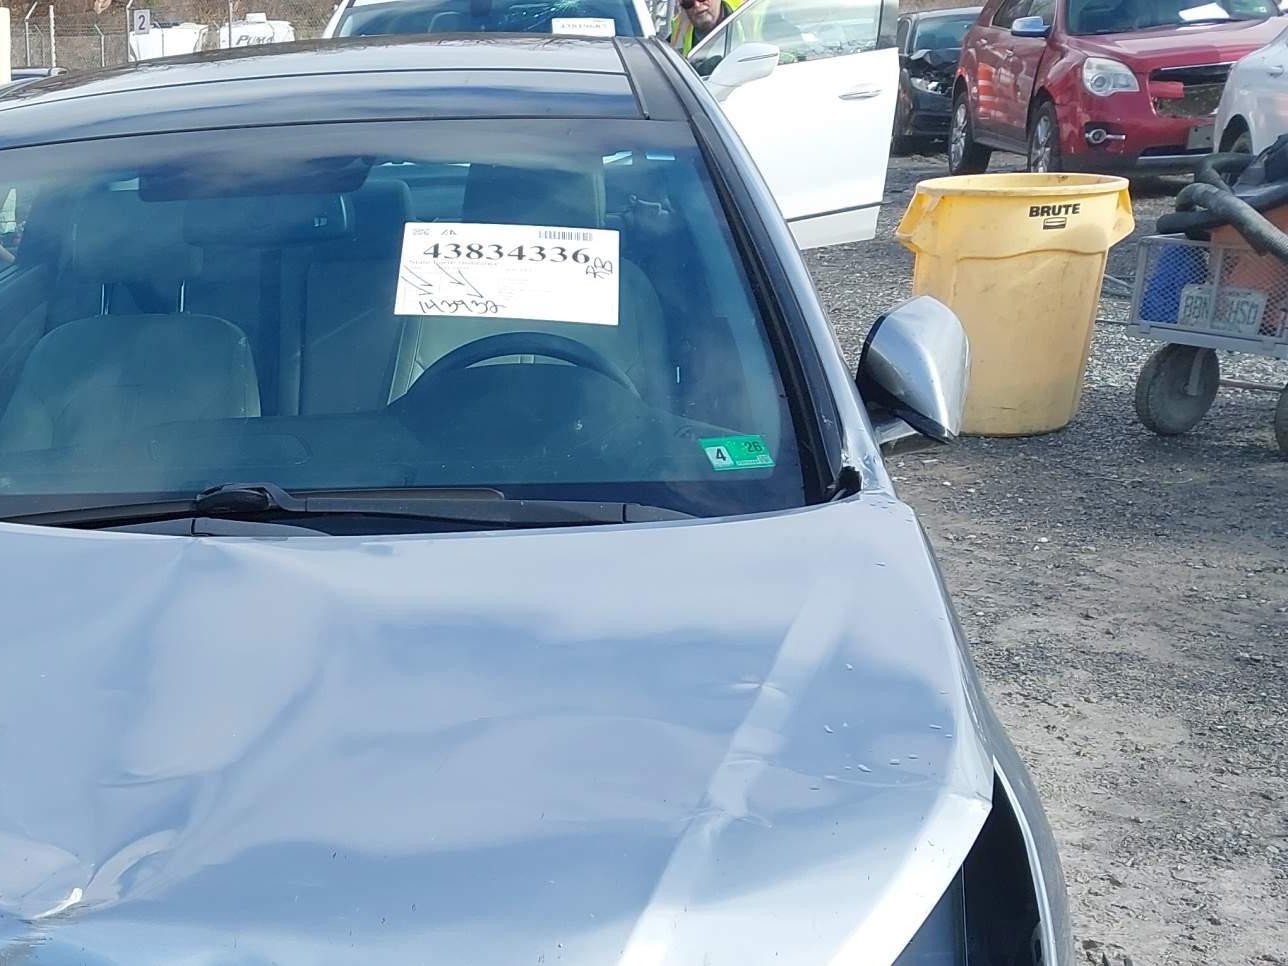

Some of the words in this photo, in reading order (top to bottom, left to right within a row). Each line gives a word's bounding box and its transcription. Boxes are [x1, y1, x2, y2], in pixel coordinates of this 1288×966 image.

[138, 14, 146, 31] 2
[1028, 203, 1081, 217] BRUTE
[423, 242, 590, 264] 43834336
[715, 448, 727, 461] 4
